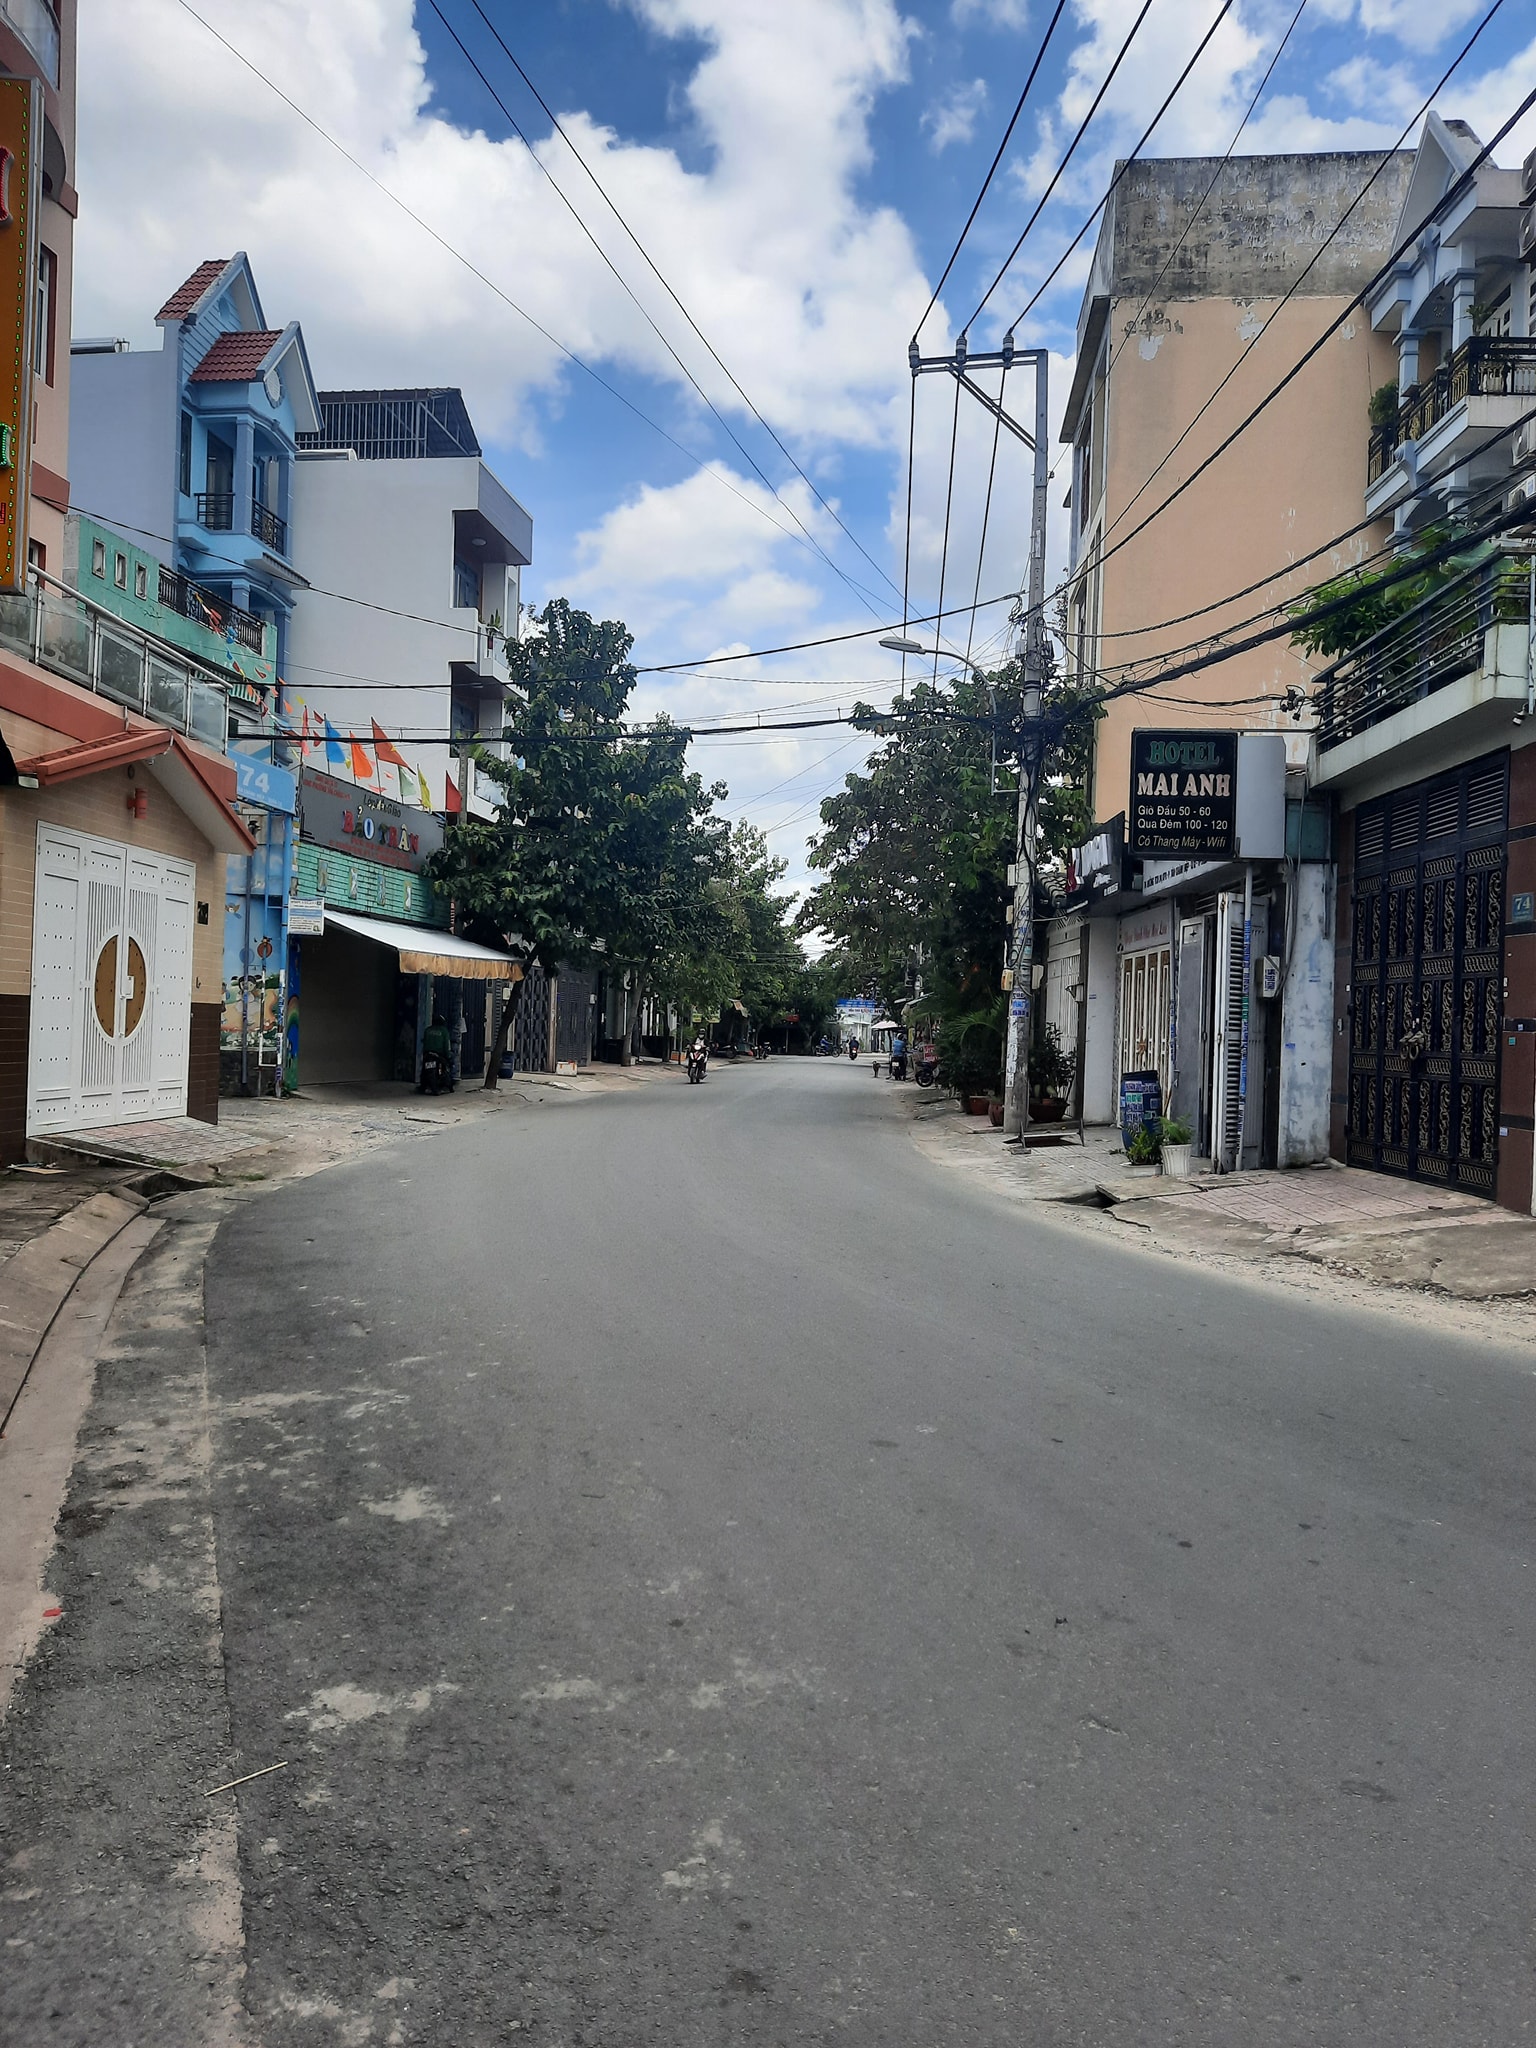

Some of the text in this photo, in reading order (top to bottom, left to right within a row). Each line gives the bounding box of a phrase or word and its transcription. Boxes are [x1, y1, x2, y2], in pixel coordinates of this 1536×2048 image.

[1149, 741, 1219, 765] HOTEL
[234, 761, 270, 793] 74
[1137, 773, 1231, 796] MAI ANH
[1178, 806, 1191, 816] 50
[1199, 806, 1211, 816] 60
[1137, 818, 1158, 829] Qua
[1185, 819, 1201, 830] 100
[1211, 820, 1228, 830] 120
[1137, 835, 1150, 846] Có
[1153, 835, 1180, 849] Thang
[1181, 836, 1201, 849] Máy
[1207, 836, 1226, 848] Wifi
[1515, 896, 1531, 910] 74
